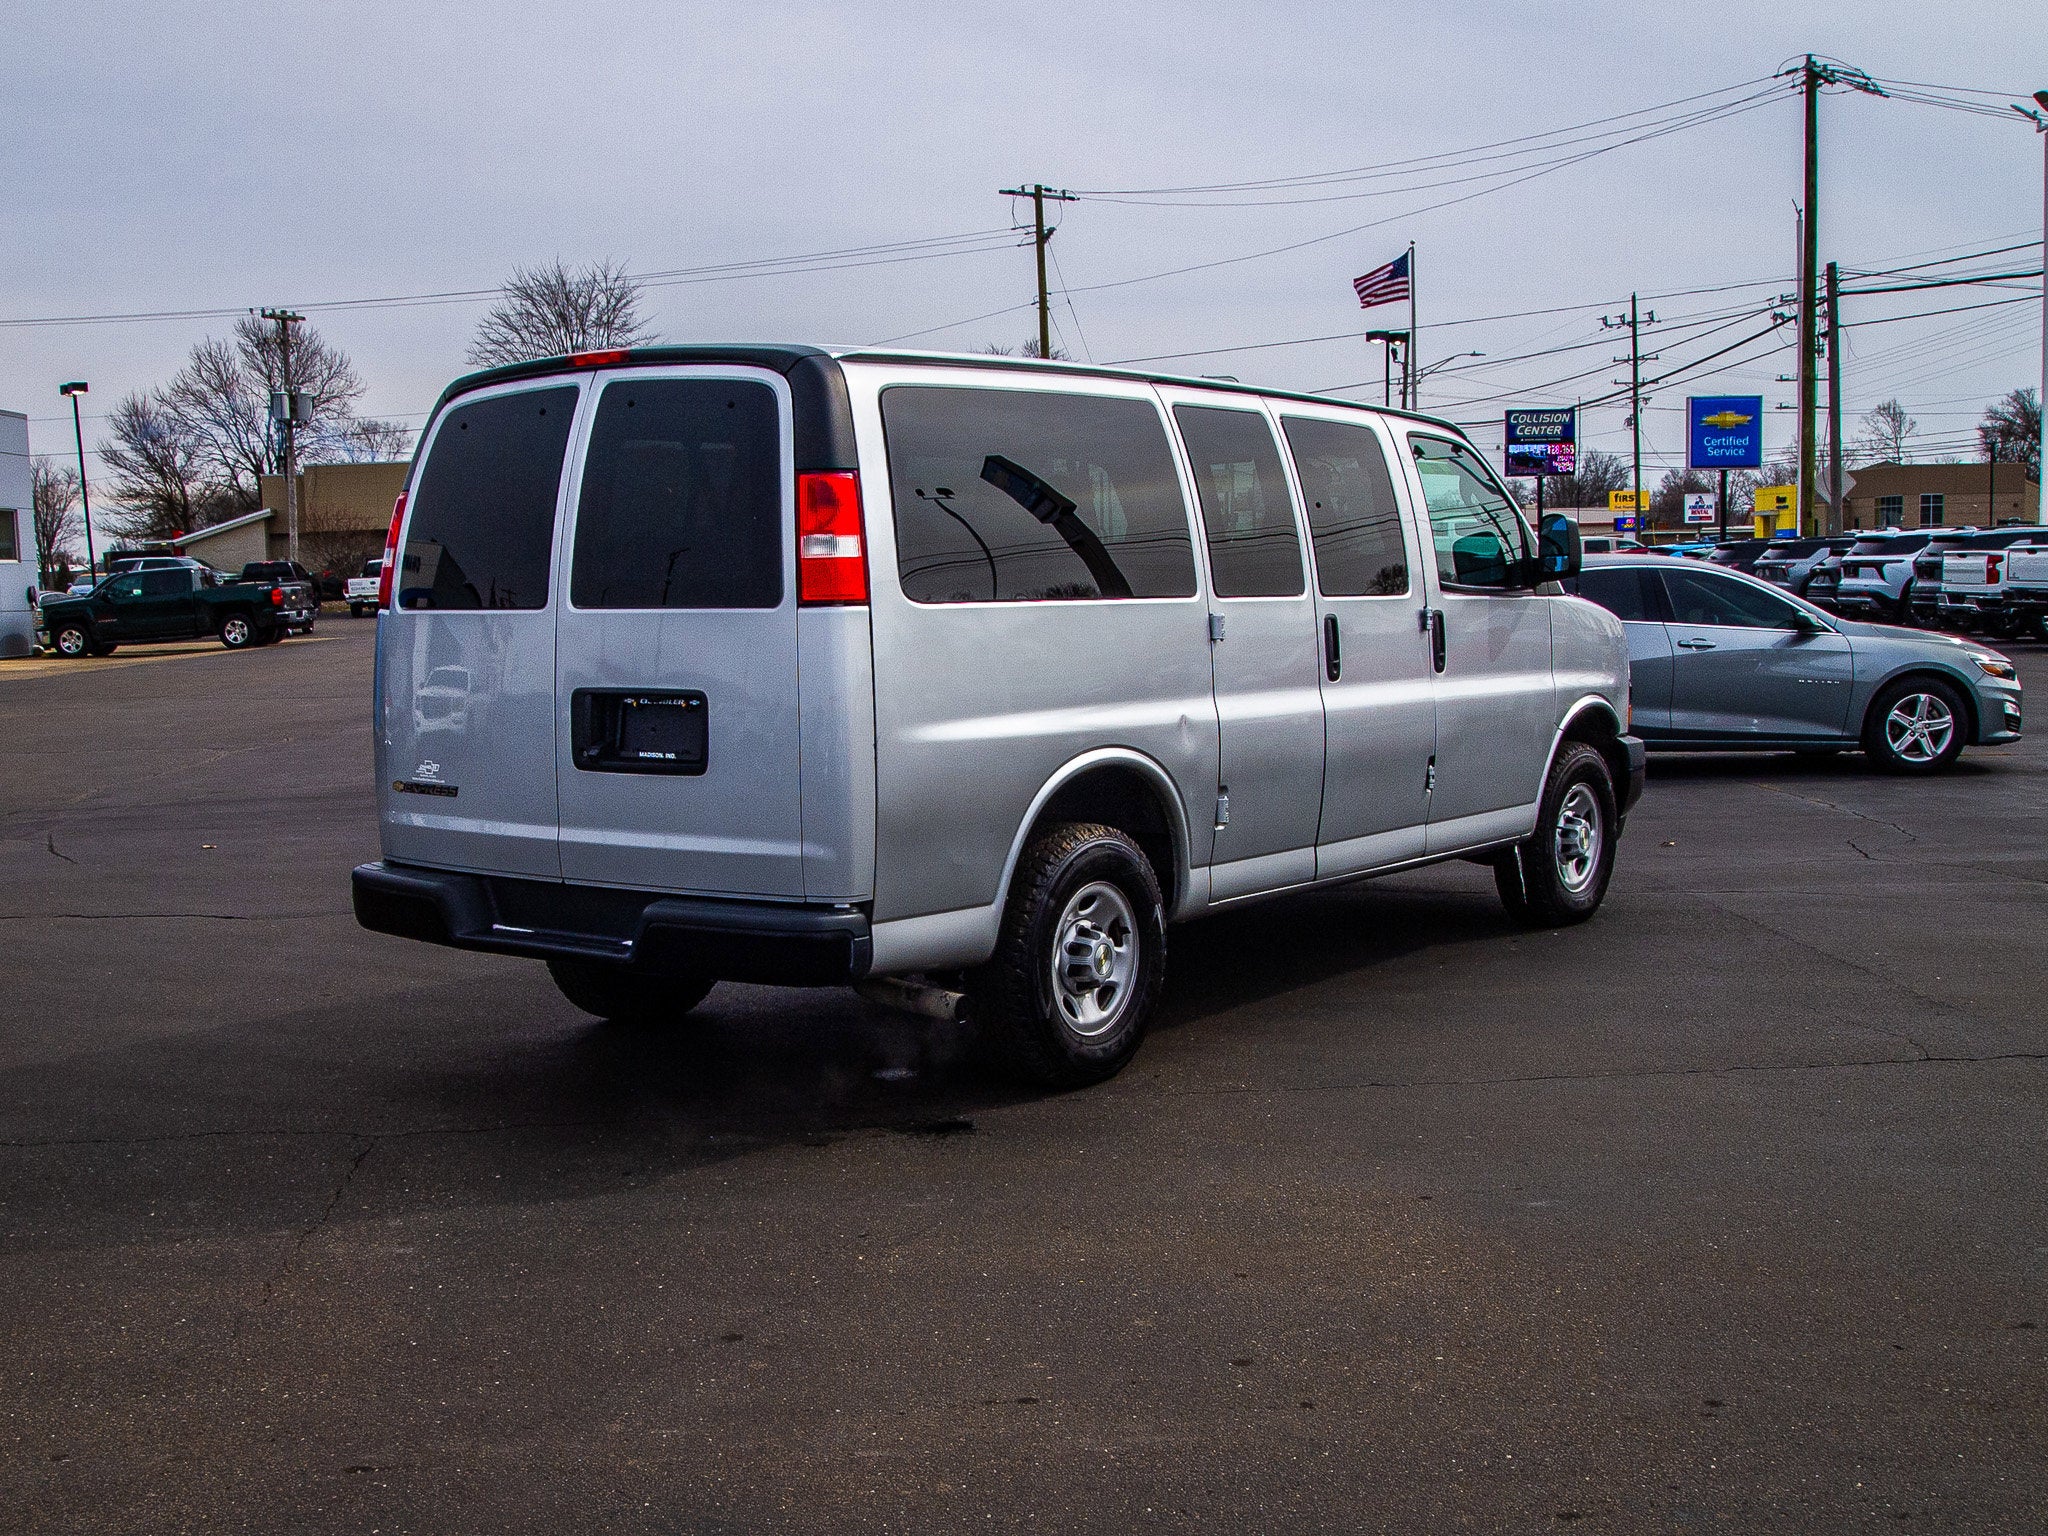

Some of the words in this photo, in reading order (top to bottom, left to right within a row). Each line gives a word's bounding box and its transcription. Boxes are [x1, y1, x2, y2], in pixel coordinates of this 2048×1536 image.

[1511, 413, 1570, 423] COLLISION
[1517, 425, 1562, 435] CENTER
[1704, 436, 1749, 446] Certified
[1707, 446, 1745, 456] Service
[1614, 493, 1636, 502] fIRS
